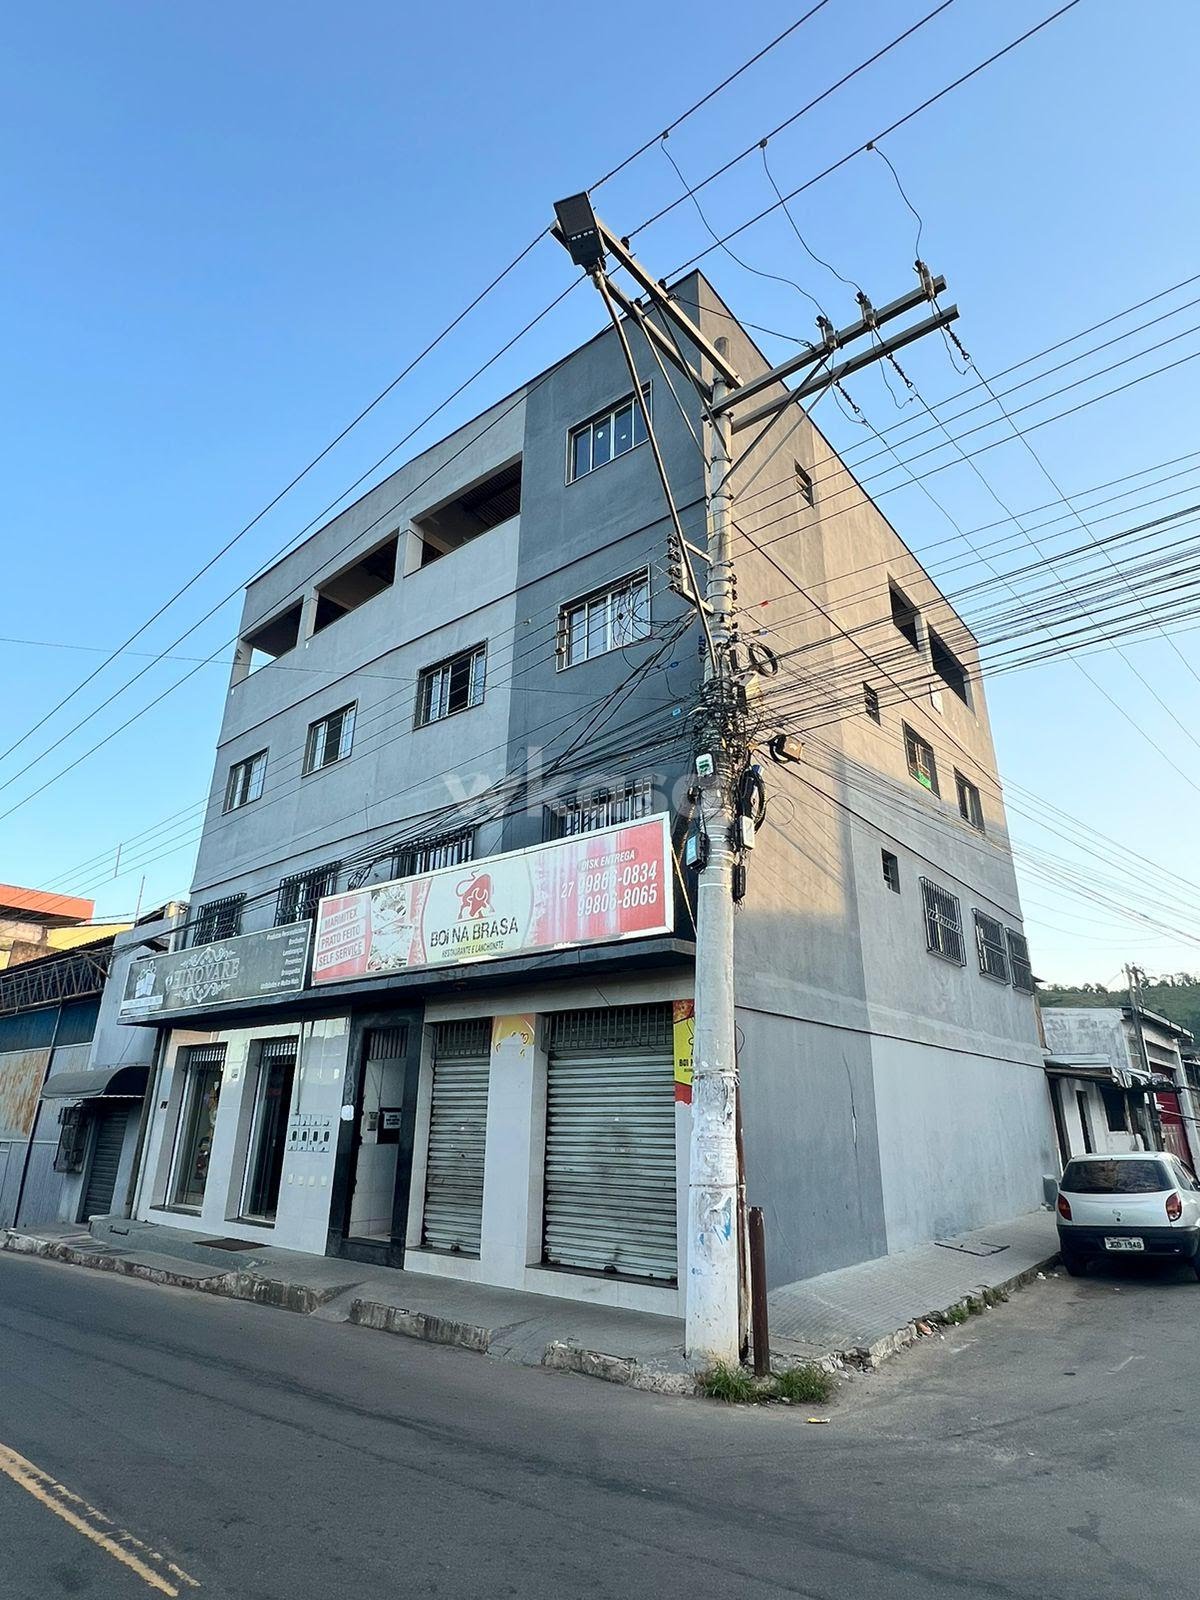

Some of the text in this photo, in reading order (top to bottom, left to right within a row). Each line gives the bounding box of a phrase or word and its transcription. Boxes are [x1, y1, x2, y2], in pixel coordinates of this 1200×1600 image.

[582, 849, 635, 871] DISK ENTREGA
[560, 881, 574, 899] 27
[324, 908, 358, 930] MARMITEX
[451, 924, 469, 944] NA
[472, 916, 519, 941] BRASA
[321, 924, 361, 950] PRATO FEITO
[318, 941, 363, 968] SELF SERVICE
